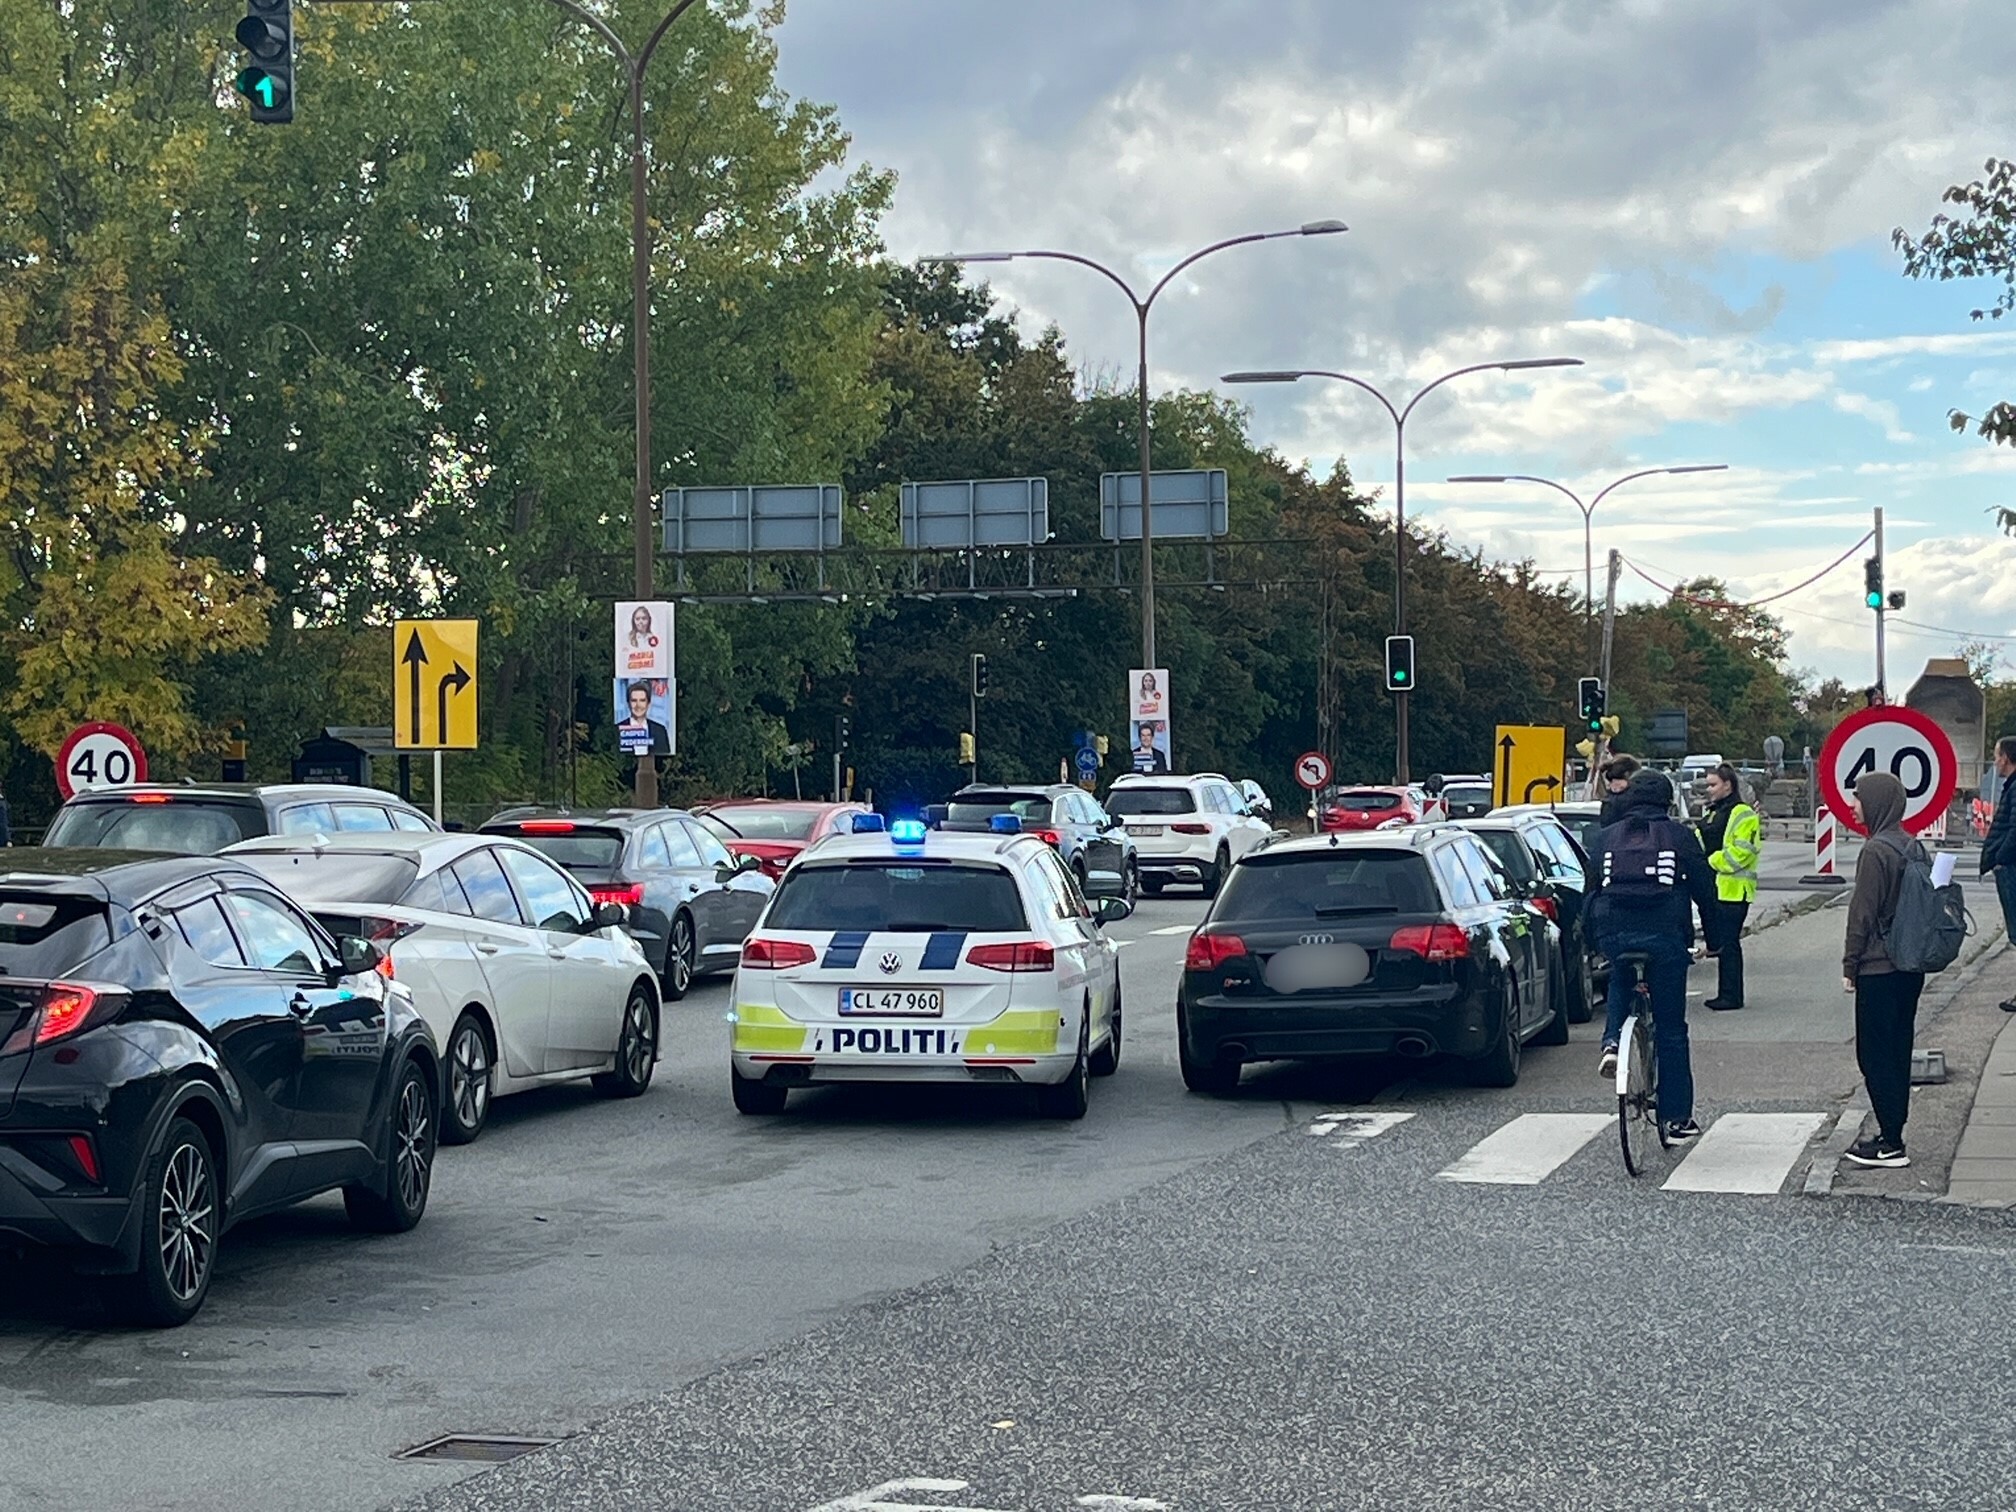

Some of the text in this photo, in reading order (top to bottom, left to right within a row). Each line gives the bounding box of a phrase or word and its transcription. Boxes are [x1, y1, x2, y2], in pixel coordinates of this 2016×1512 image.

[71, 749, 130, 784] 40
[1844, 746, 1931, 798] 40
[853, 992, 939, 1010] CL 47 960
[832, 1028, 945, 1054] POLITI
